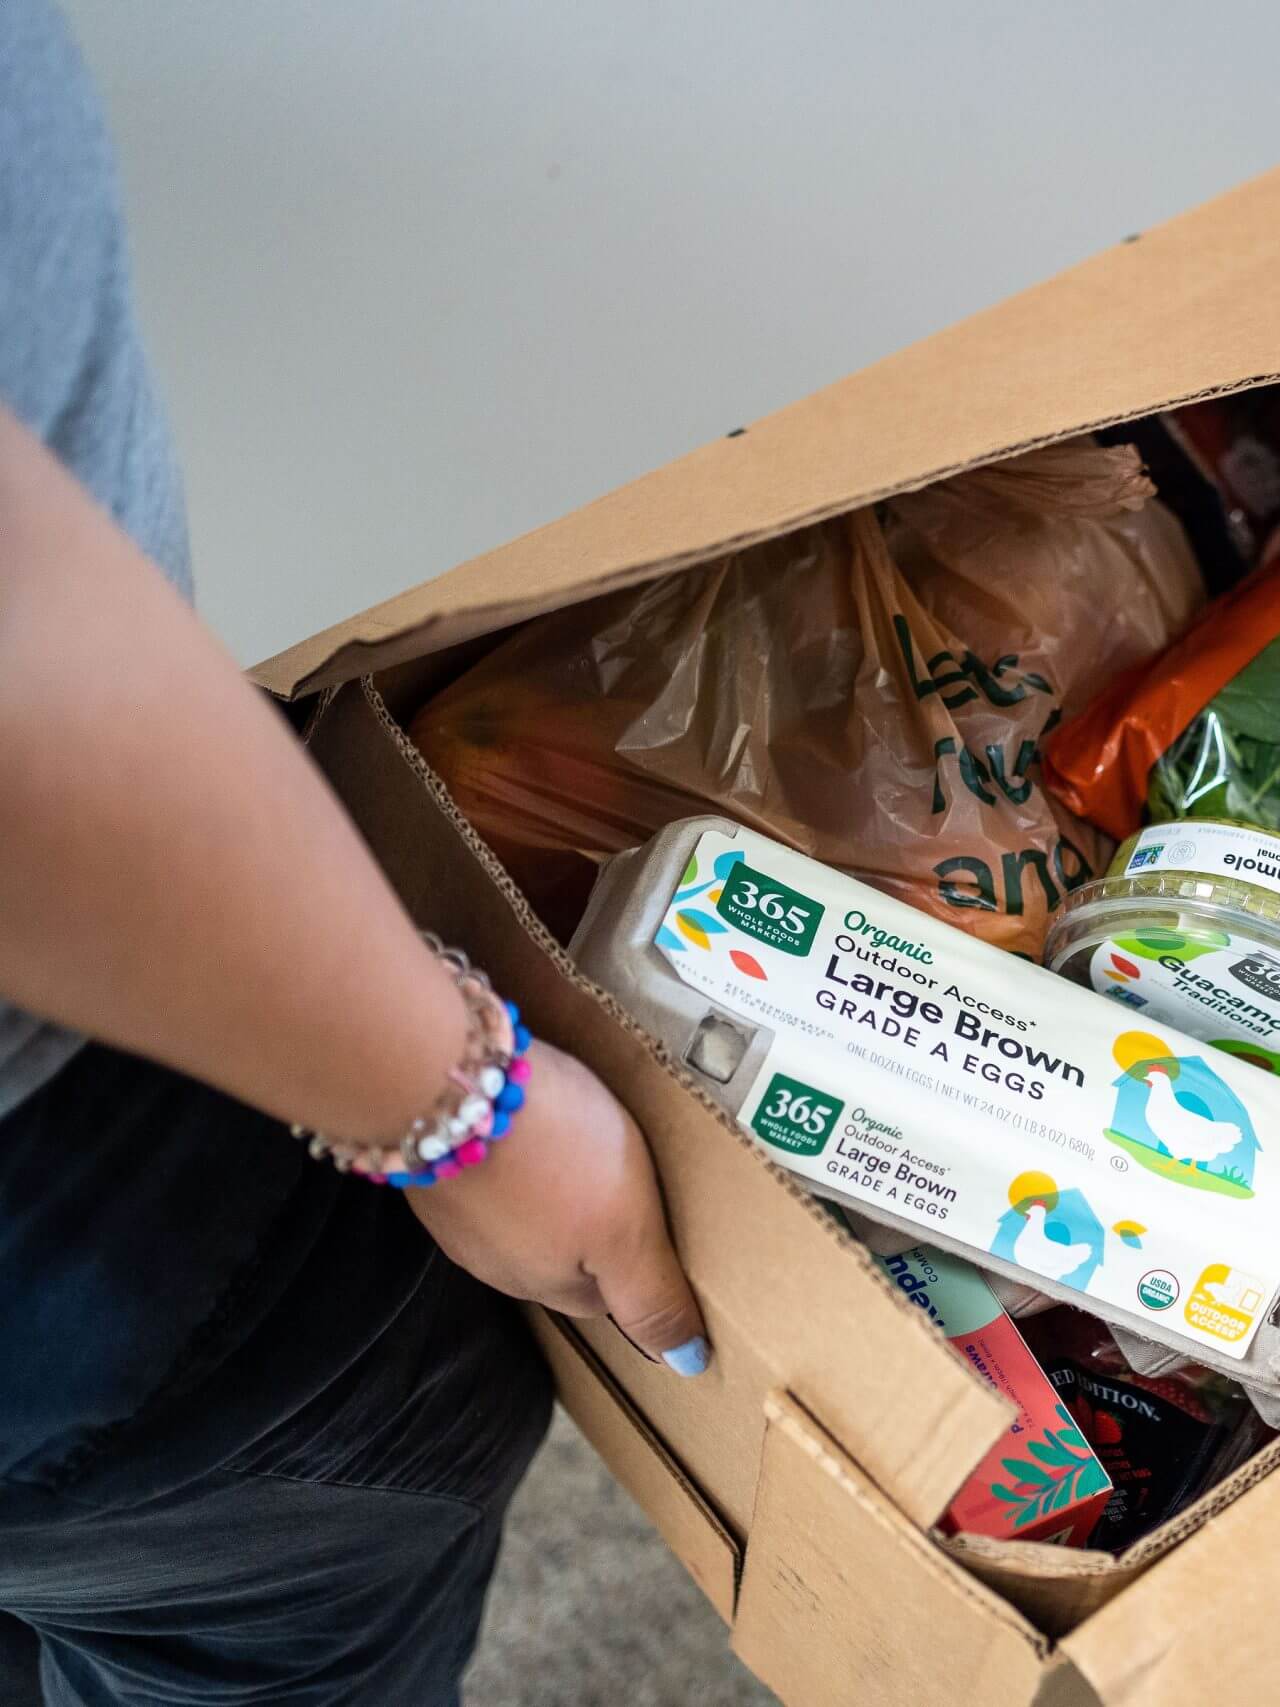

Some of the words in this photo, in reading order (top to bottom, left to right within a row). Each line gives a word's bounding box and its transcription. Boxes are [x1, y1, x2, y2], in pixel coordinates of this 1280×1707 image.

[725, 903, 765, 929] WHOLE
[764, 923, 802, 948] FOODS
[729, 881, 810, 933] 365
[738, 917, 785, 946] MARKET
[844, 911, 933, 964] Organic
[835, 935, 938, 988] Outdoor
[825, 954, 943, 1024] Large
[954, 1010, 1084, 1087] Brown
[1172, 976, 1273, 1038] Traditional
[816, 990, 920, 1047] GRADE
[930, 1042, 948, 1062] A
[963, 1054, 1044, 1099] EGGS
[844, 1041, 867, 1058] ONE
[868, 1052, 905, 1076] DOZEN
[904, 1068, 934, 1089] EGGS
[939, 1083, 962, 1101] NET
[959, 1092, 981, 1109] WT
[979, 1101, 995, 1116] 24
[993, 1107, 1012, 1123] OZ
[759, 1116, 790, 1135] WHOLE
[788, 1129, 818, 1147] FOODS
[766, 1090, 832, 1134] 365
[852, 1108, 902, 1139] Organic
[767, 1128, 803, 1150] MARKET
[844, 1125, 898, 1154] Outdoor
[827, 1161, 883, 1192] GRADE
[887, 1187, 896, 1198] A
[904, 1193, 948, 1219] EGGS
[836, 1138, 891, 1173] Large
[894, 1163, 956, 1202] Brown
[1149, 1275, 1172, 1292] USDA
[1189, 1301, 1247, 1332] OUTDOOR
